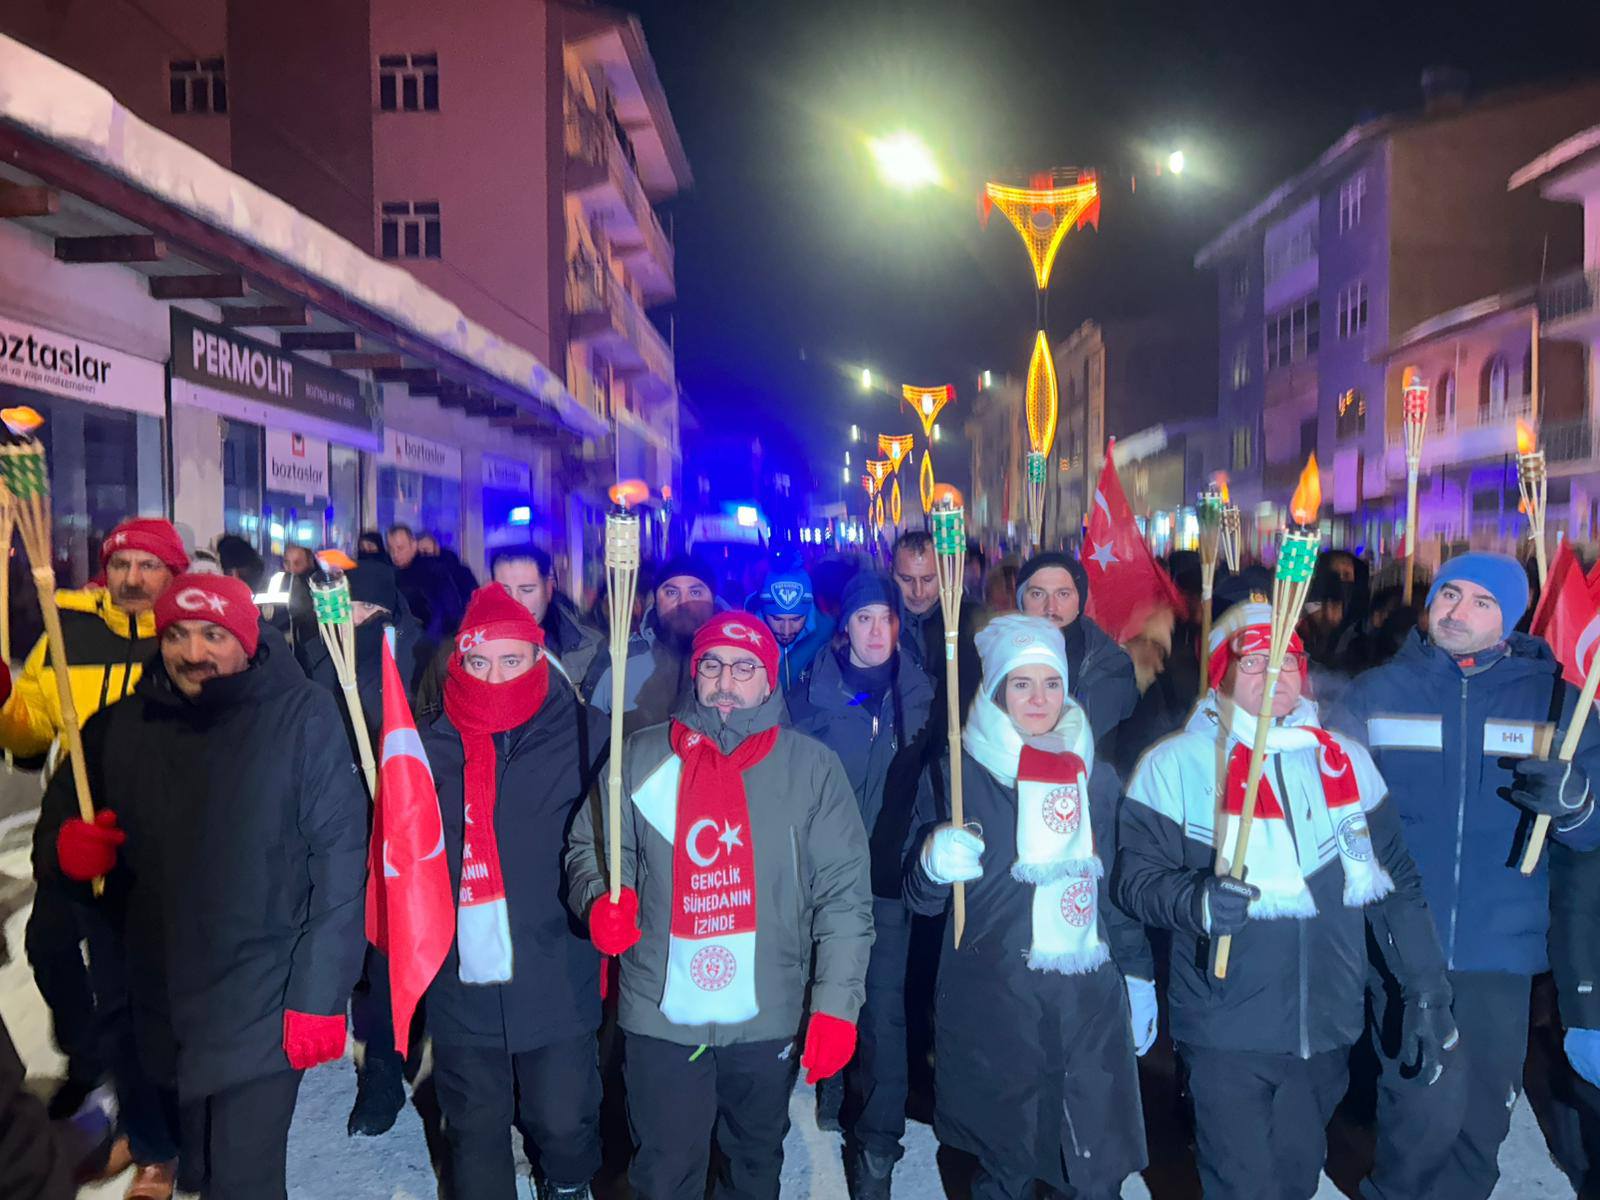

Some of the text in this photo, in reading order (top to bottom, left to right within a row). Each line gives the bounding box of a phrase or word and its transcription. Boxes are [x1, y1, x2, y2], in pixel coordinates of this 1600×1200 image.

[192, 327, 293, 398] PERMOLIT
[690, 864, 741, 890] GENÇLİK
[693, 914, 735, 935] İZİNDE
